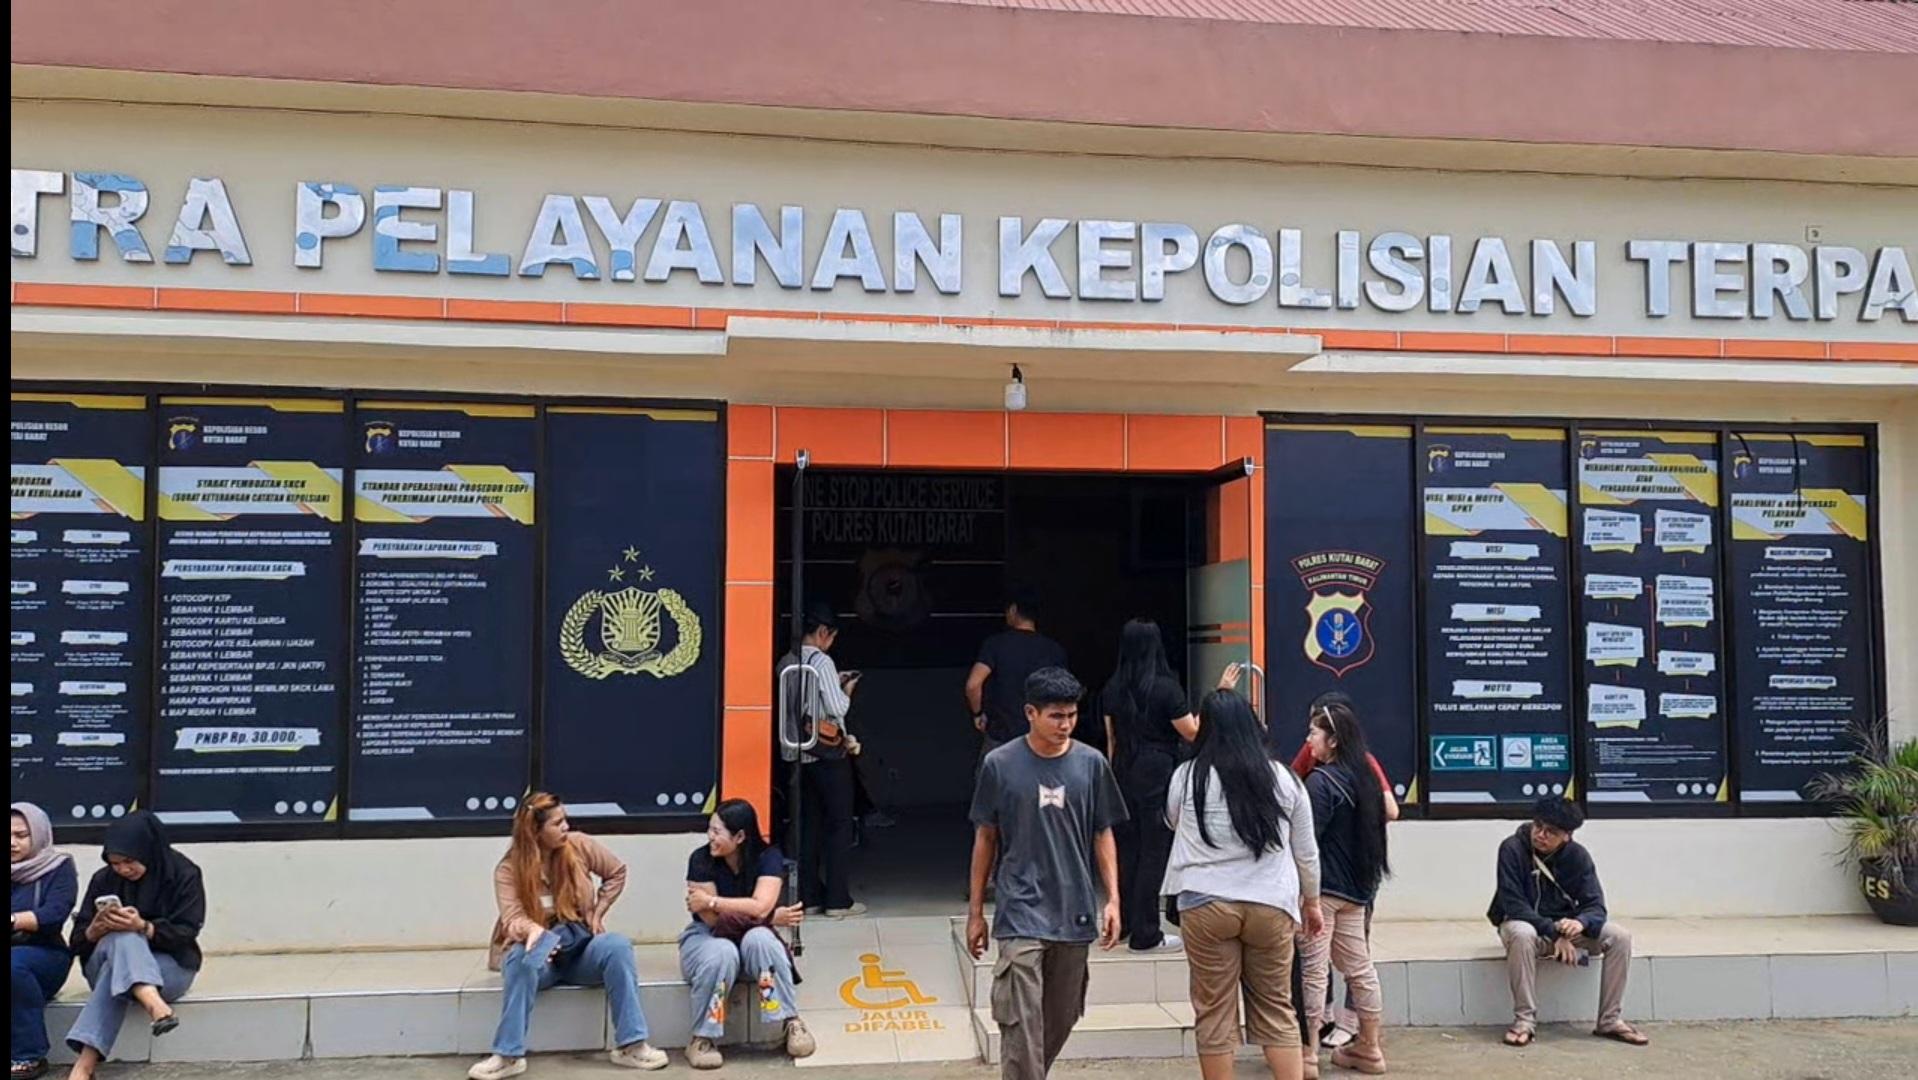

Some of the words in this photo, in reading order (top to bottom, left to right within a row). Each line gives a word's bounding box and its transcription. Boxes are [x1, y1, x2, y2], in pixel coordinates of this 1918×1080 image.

[11, 168, 253, 266] TRA
[294, 180, 962, 295] PELAYANAN
[998, 215, 1597, 319] KEPOLISIAN
[1626, 239, 1918, 322] TERPA
[197, 480, 229, 488] SYARAT
[230, 480, 280, 488] PEMBUATAN
[282, 480, 307, 488] SKCK
[362, 482, 400, 491] STANDAR
[401, 482, 458, 492] OPERASIONAL
[459, 483, 503, 492] PROSEDUR
[28, 489, 83, 498] KEHILANGAN
[202, 493, 250, 502] KETERANGAN
[252, 494, 285, 502] CATATAN
[802, 477, 825, 505] NE
[829, 477, 869, 506] STOP
[873, 478, 927, 507] POLICE
[931, 479, 994, 509] SERVICE
[382, 495, 435, 503] PENERIMAAN
[437, 495, 474, 504] LAPORAN
[476, 496, 503, 504] POLISI
[1446, 494, 1467, 503] MISI
[1475, 494, 1504, 503] MOTTO
[1733, 500, 1776, 508] MAKLUMAT
[1451, 505, 1473, 513] SPKT
[812, 512, 873, 544] POLRES
[878, 512, 922, 544] KUTAI
[927, 512, 976, 544] BARAT
[1774, 520, 1794, 528] SPKT
[373, 543, 423, 551] PERSYARATAN
[424, 543, 458, 551] LAPORAN
[459, 544, 482, 552] POLISI
[1298, 554, 1327, 569] POLRES
[1328, 553, 1353, 564] KUTAI
[1355, 555, 1380, 570] BARAT
[226, 564, 271, 572] PEMBUATAN
[272, 564, 292, 572] SKCK
[171, 606, 213, 614] SEBANYAK
[220, 606, 253, 614] LEMBAR
[170, 617, 213, 625] FOTOCOPY
[215, 617, 241, 625] KARTU
[243, 617, 286, 625] KELUARGA
[170, 640, 213, 648] FOTOCOPY
[170, 651, 213, 659] SEBANYAK
[220, 651, 253, 659] LEMBAR
[170, 674, 211, 682] SEBANYAK
[220, 674, 253, 682] LEMBAR
[190, 685, 230, 693] PEMOHON
[290, 684, 311, 692] SKCK
[1483, 684, 1512, 692] MOTTO
[169, 708, 187, 716] MAP
[187, 708, 216, 716] MERAH
[223, 708, 257, 716] LEMBAR
[195, 732, 228, 745] PNBP
[230, 732, 248, 745] Rp.
[252, 731, 302, 743] 30.000.-
[860, 1010, 929, 1021] JALUR
[844, 1020, 946, 1033] DIFABEL
